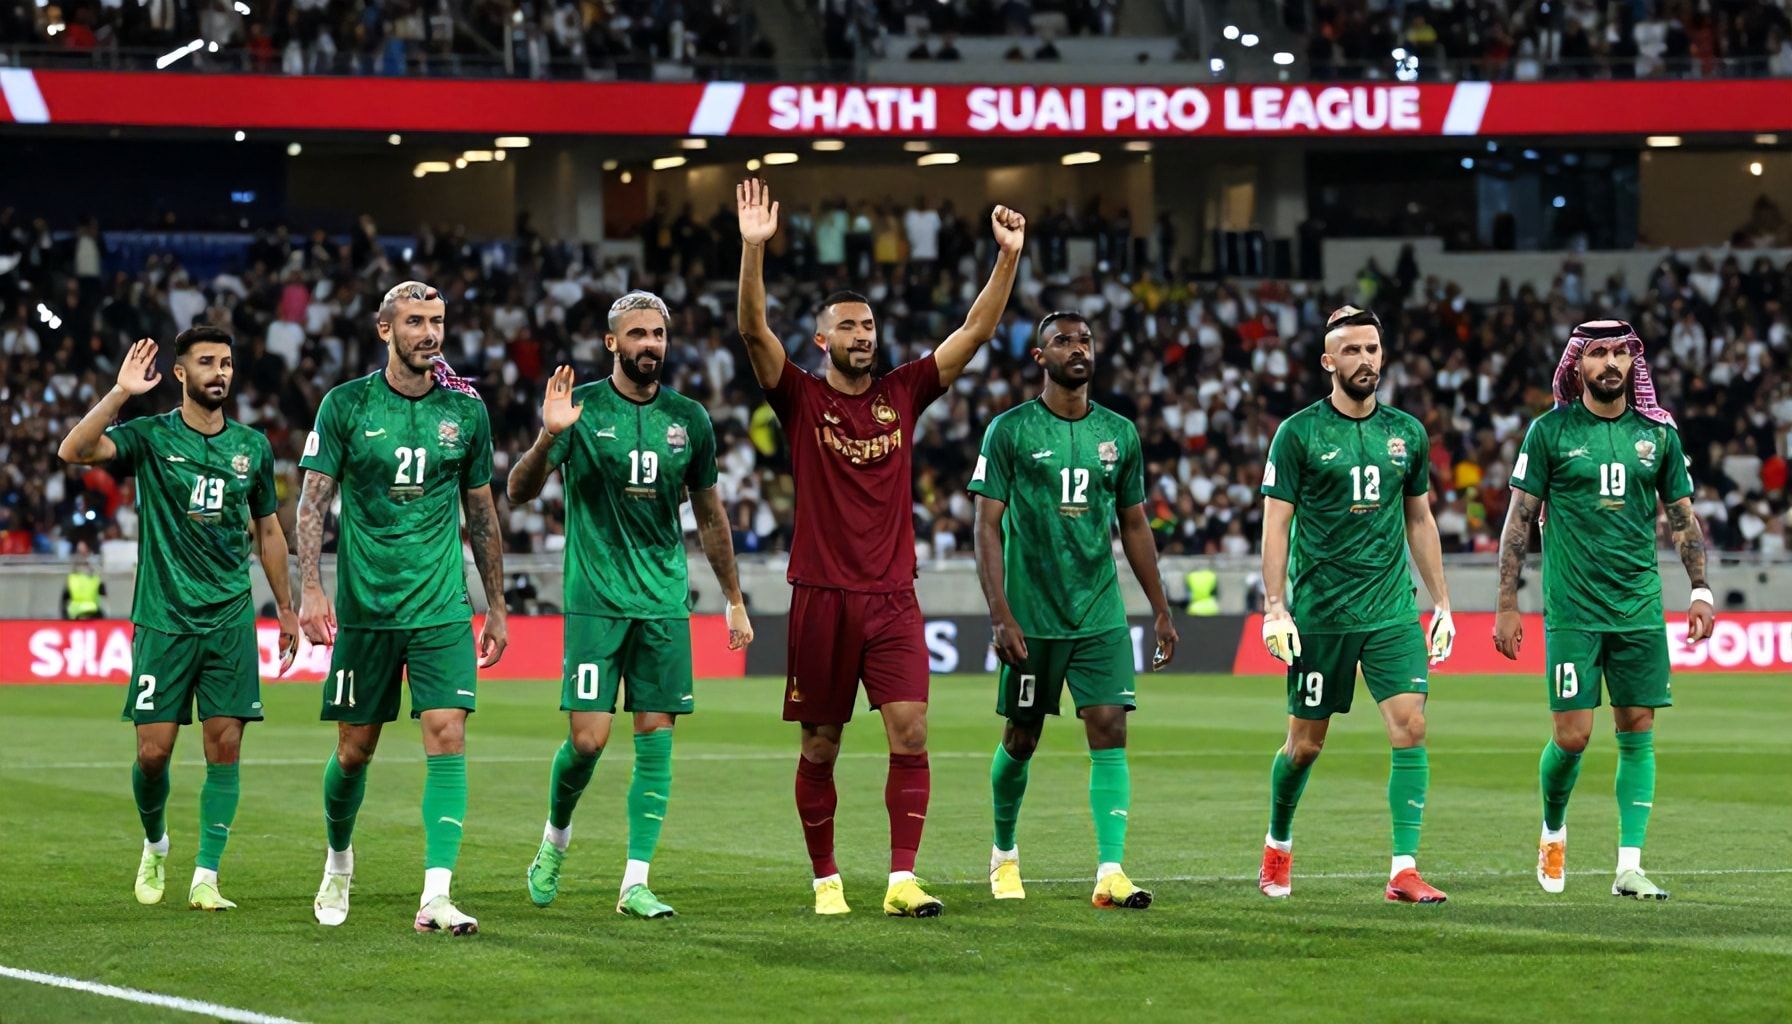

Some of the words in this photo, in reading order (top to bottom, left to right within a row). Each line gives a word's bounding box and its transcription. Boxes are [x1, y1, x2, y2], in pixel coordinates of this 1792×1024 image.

[769, 86, 937, 131] SHATH
[967, 87, 1086, 131] SUAI
[1102, 87, 1210, 131] PRO
[1225, 87, 1420, 131] LEAGUE
[394, 446, 426, 484] 21
[1060, 467, 1090, 503] 12
[135, 674, 156, 710] 2
[577, 663, 599, 700] 0
